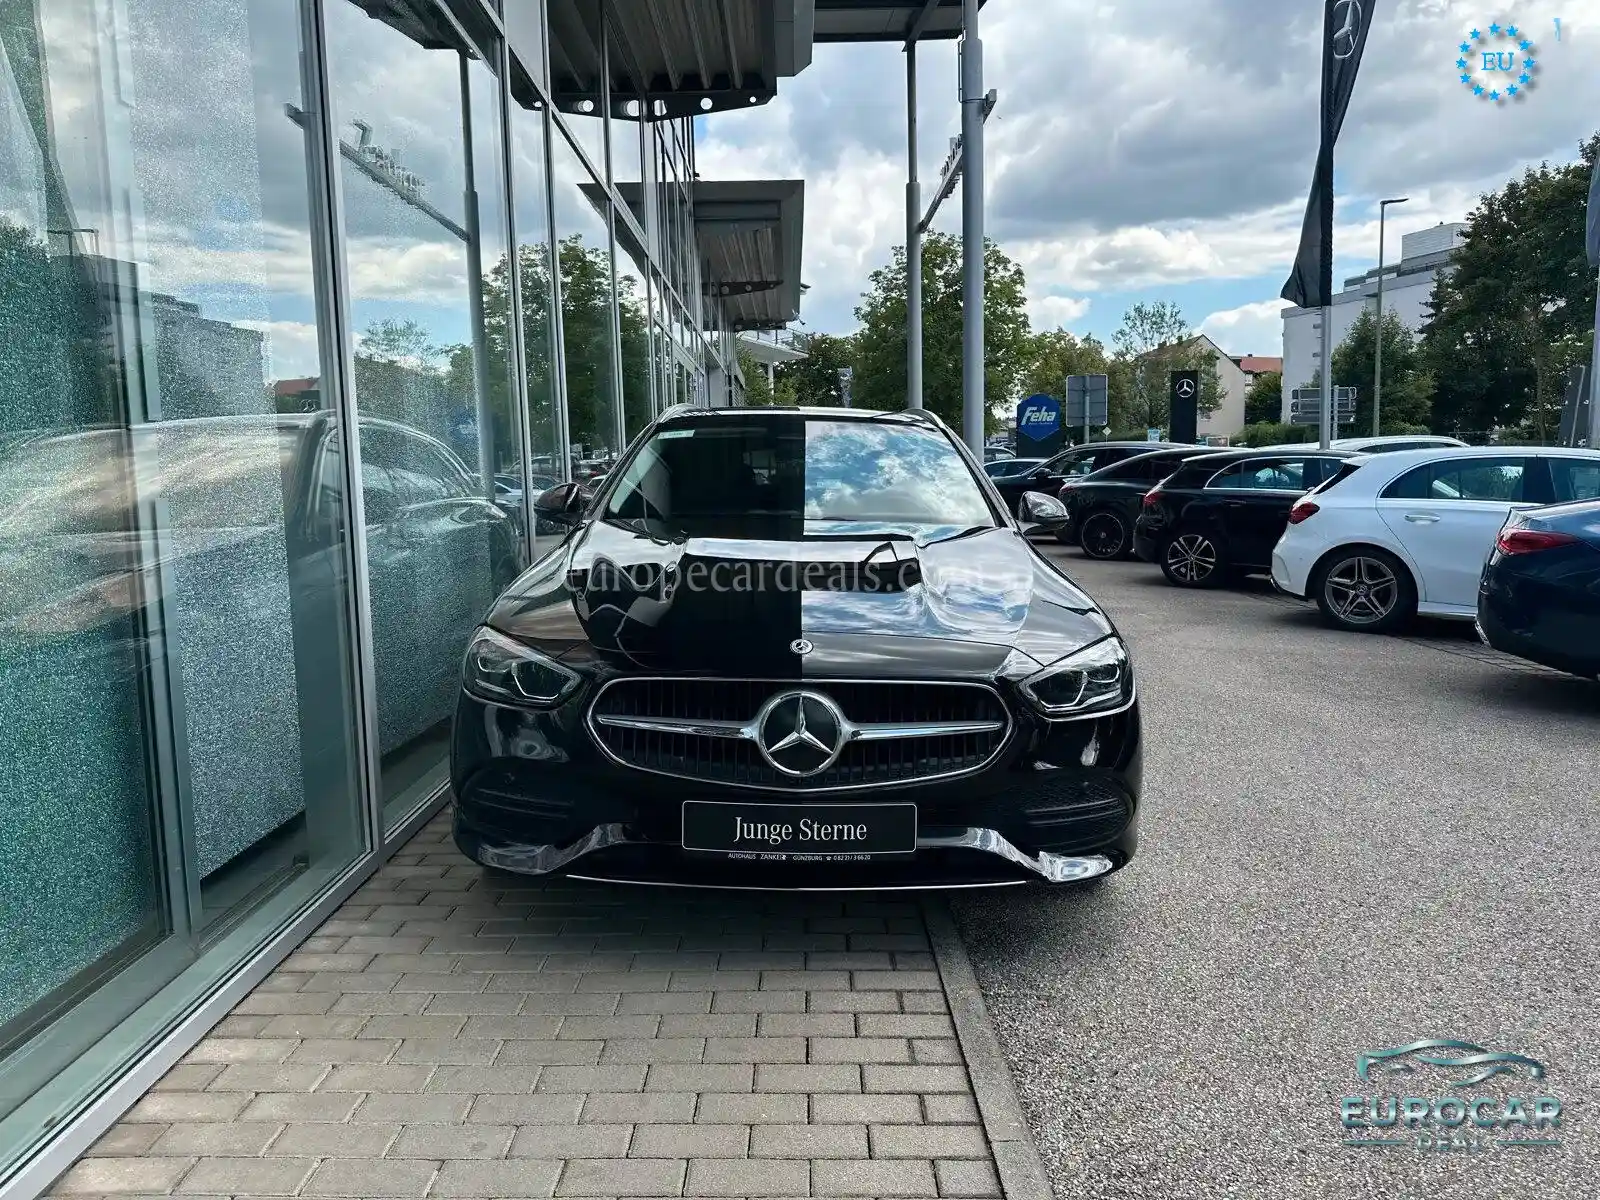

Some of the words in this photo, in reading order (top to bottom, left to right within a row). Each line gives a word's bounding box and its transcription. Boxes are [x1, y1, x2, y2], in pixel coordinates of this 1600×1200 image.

[1021, 406, 1056, 425] Feha
[733, 816, 793, 845] Junge
[799, 818, 868, 841] Sterne
[727, 852, 757, 860] AUTOHAUS
